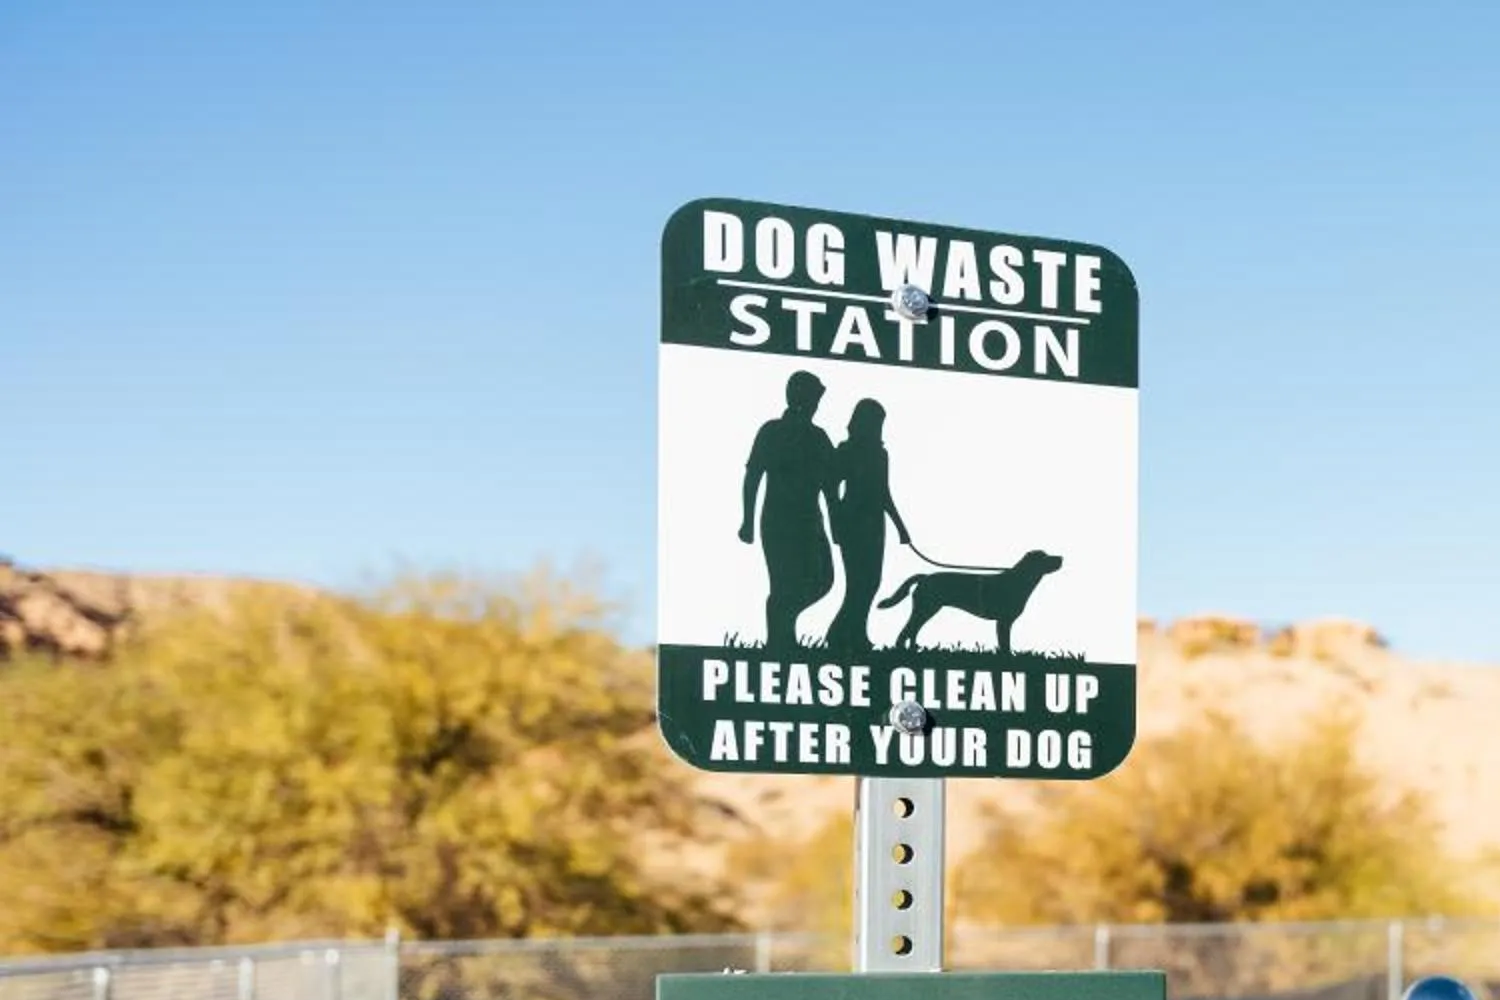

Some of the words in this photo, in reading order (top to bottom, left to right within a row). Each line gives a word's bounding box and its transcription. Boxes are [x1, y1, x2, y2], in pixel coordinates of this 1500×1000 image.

[703, 209, 845, 286] DOG
[875, 231, 1103, 313] WASTE
[728, 294, 1080, 377] STATION
[702, 659, 871, 707] PLEASE
[889, 667, 1026, 713] CLEAN
[1044, 673, 1099, 715] UP
[709, 720, 851, 763] AFTER
[869, 726, 987, 768] YOUR
[1006, 729, 1093, 770] DOG
